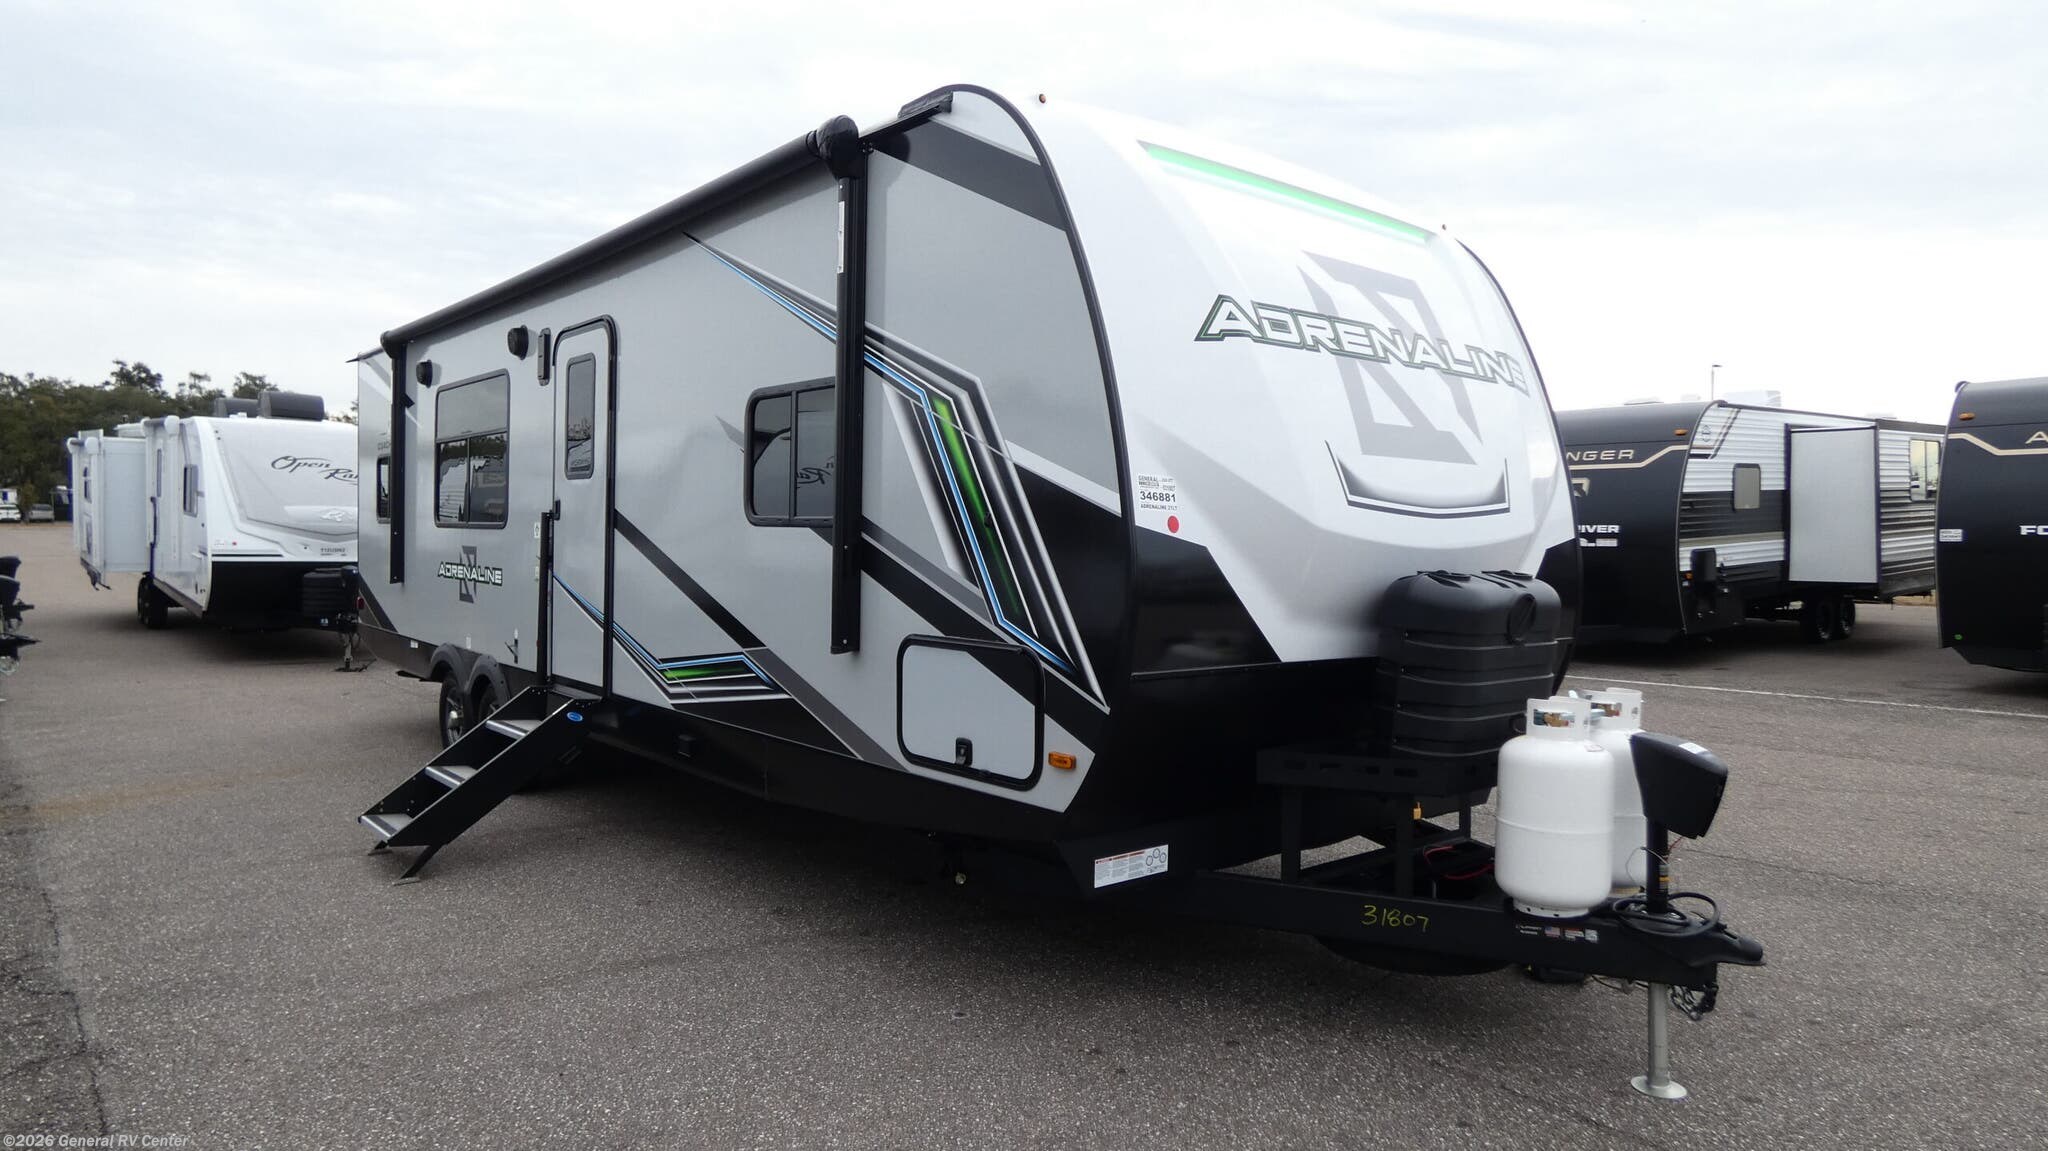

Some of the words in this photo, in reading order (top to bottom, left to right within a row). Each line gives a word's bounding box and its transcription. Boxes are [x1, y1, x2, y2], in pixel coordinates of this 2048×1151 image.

[1194, 294, 1530, 397] ADRENALINE
[271, 456, 331, 473] Open
[1139, 490, 1176, 503] 346881
[1578, 525, 1620, 533] IVER
[437, 561, 503, 587] ADRENALINE
[1361, 904, 1430, 933] 31807
